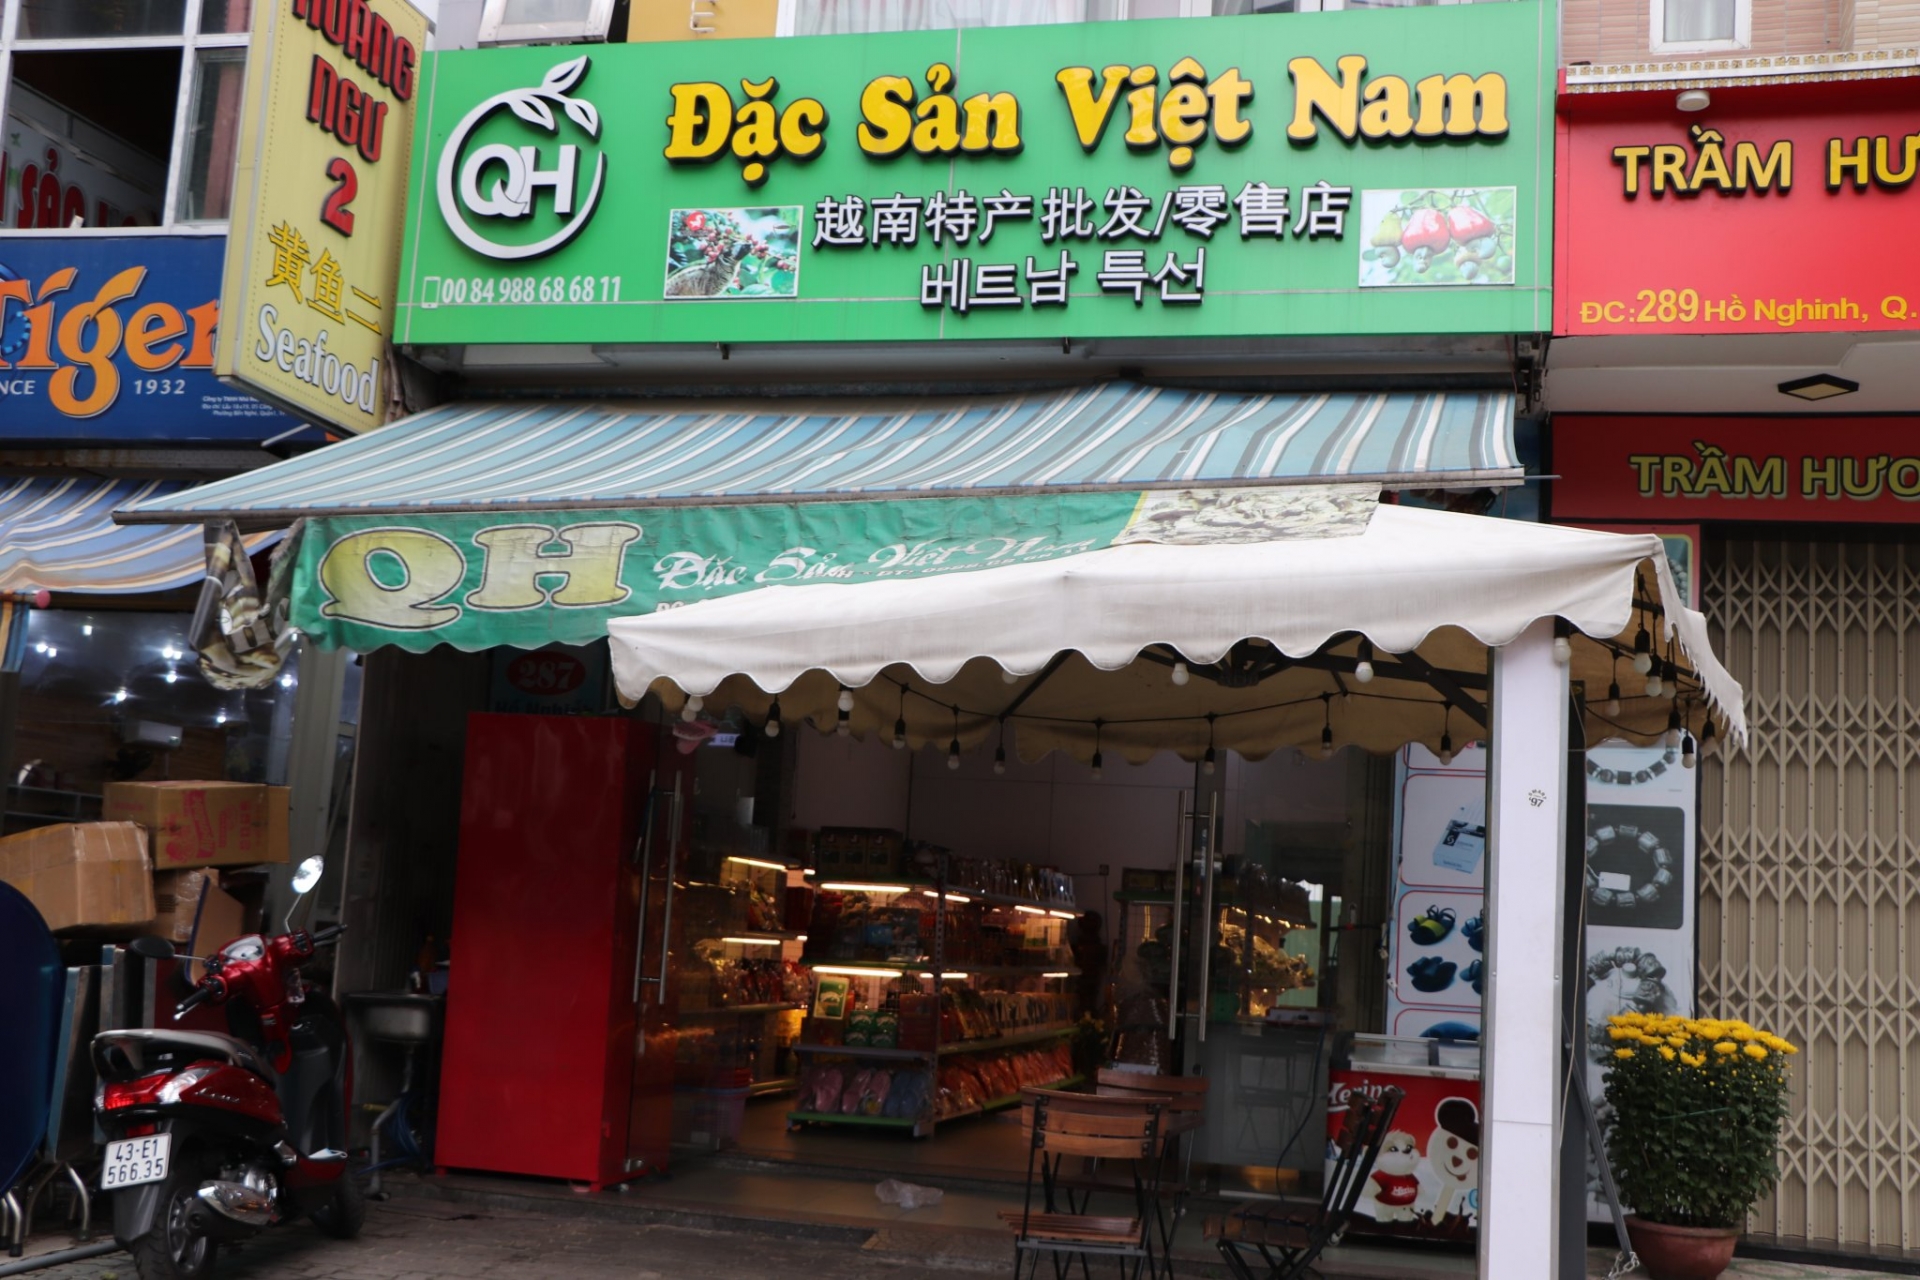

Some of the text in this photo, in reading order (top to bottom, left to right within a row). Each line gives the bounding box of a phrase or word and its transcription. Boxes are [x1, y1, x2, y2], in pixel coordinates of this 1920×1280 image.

[664, 54, 1511, 188] Đặc Sản Việt Nam
[460, 142, 580, 218] QH
[1612, 125, 1793, 195] TRẦM
[321, 157, 358, 237] 2
[812, 180, 1353, 249] 越南特产批发/零售店
[265, 221, 382, 335] 黄鱼二
[442, 276, 621, 303] 00 84 988 68 68 11
[920, 247, 1207, 314] 베트남 특선
[1704, 295, 1747, 321] Hồ
[1754, 298, 1869, 326] Nghinh,
[1880, 295, 1918, 319] Q.
[135, 379, 186, 394] 1932
[256, 304, 379, 415] Seafood
[1629, 440, 1786, 498] TRẦM
[319, 521, 642, 631] QH
[518, 661, 575, 688] 287
[107, 1157, 164, 1185] 566.35
[115, 1139, 158, 1161] 43-E1
